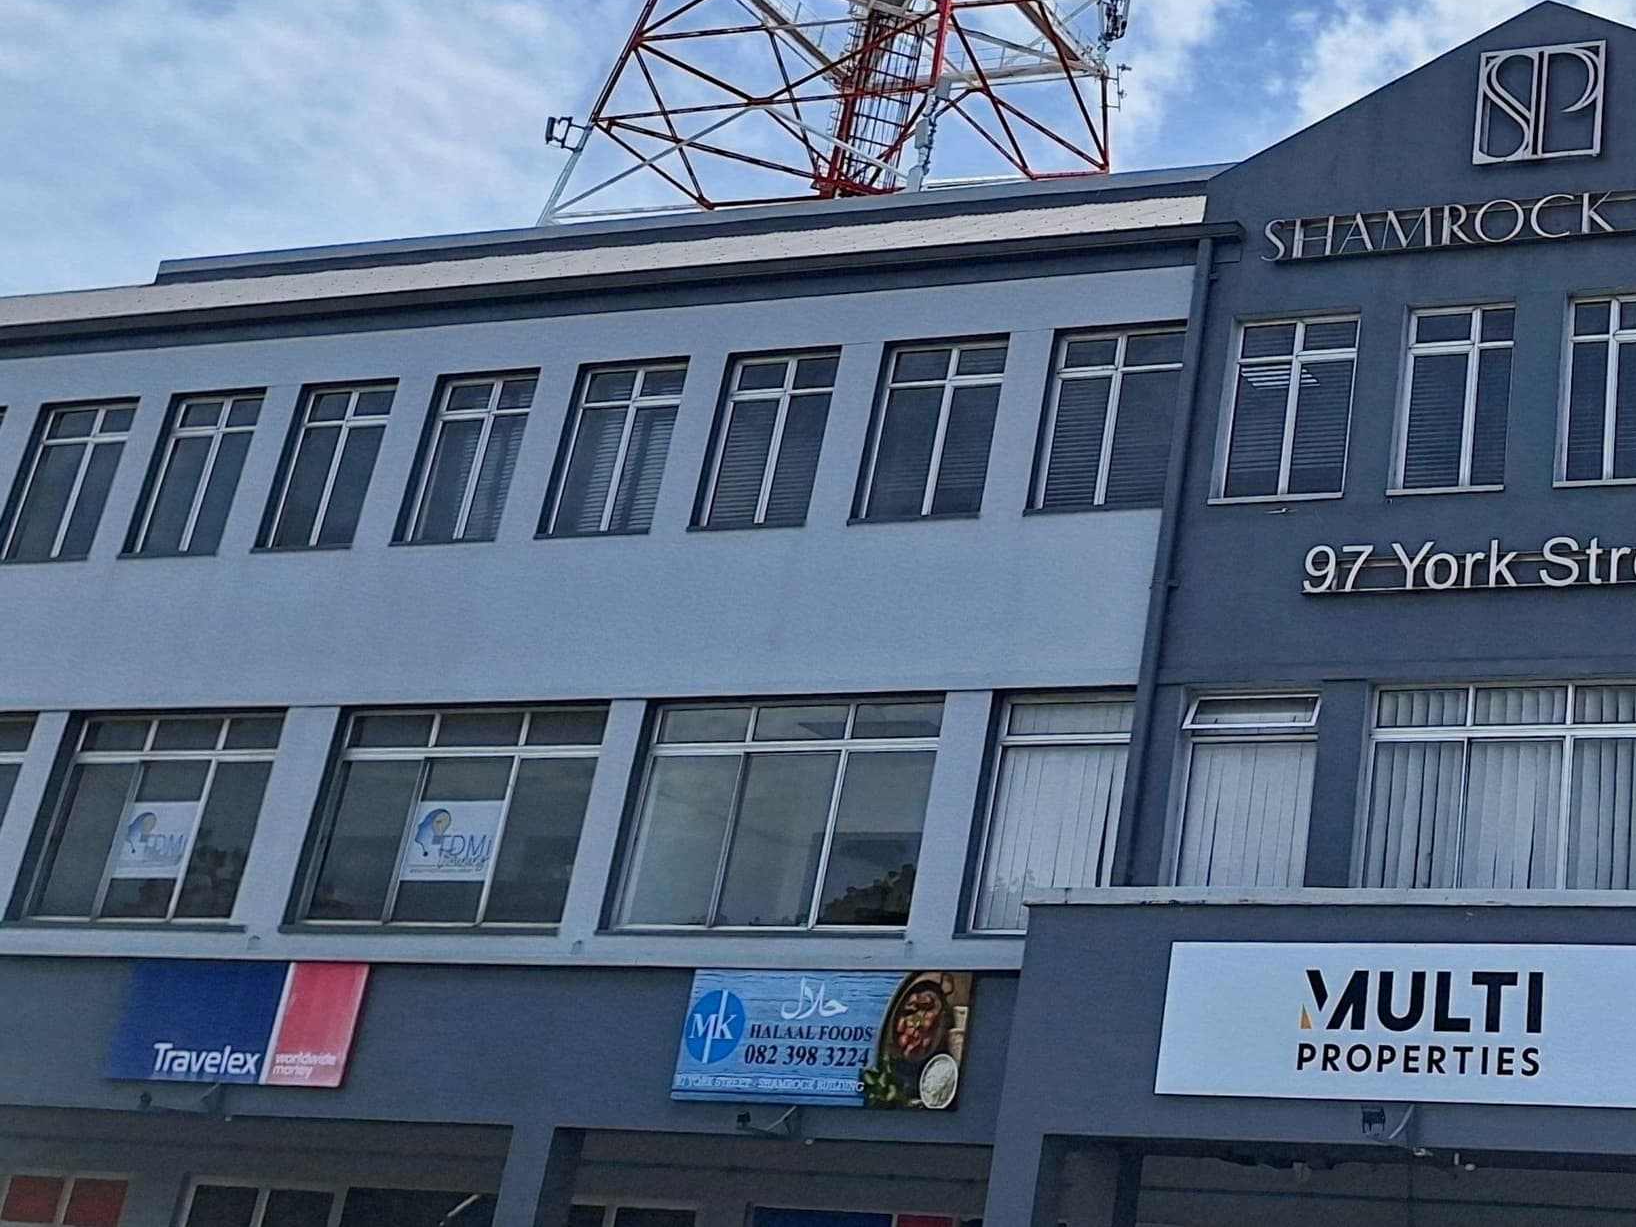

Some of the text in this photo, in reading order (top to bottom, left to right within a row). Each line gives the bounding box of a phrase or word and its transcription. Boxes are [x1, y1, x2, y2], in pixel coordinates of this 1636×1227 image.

[1261, 190, 1616, 262] SHAMROCK
[1302, 544, 1374, 593] 97
[1391, 539, 1520, 590] York
[780, 976, 849, 1020] حلال
[1300, 969, 1544, 1034] MULTI
[750, 1023, 874, 1042] HALAAL FOODS
[153, 1042, 261, 1075] Travelex
[272, 1064, 314, 1079] money
[275, 1051, 337, 1066] worldwide
[744, 1044, 871, 1068] 082 398 3224
[1296, 1043, 1541, 1077] PROPERTIES
